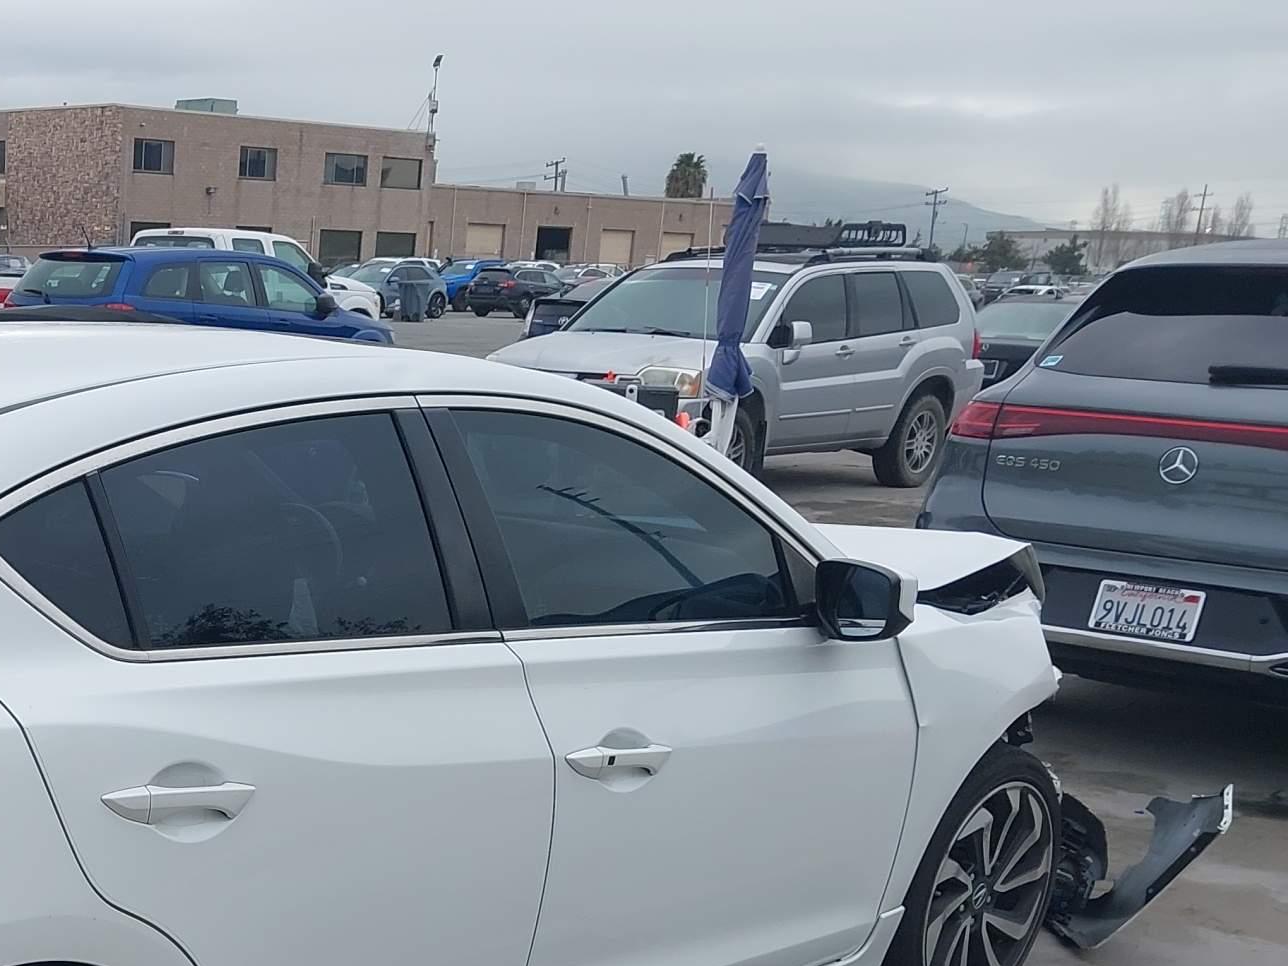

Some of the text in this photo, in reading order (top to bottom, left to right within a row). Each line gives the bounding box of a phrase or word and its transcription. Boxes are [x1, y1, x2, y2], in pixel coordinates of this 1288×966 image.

[995, 454, 1061, 471] EQS 450
[1098, 599, 1188, 633] 9VJL014
[1100, 622, 1147, 635] FLETCHER
